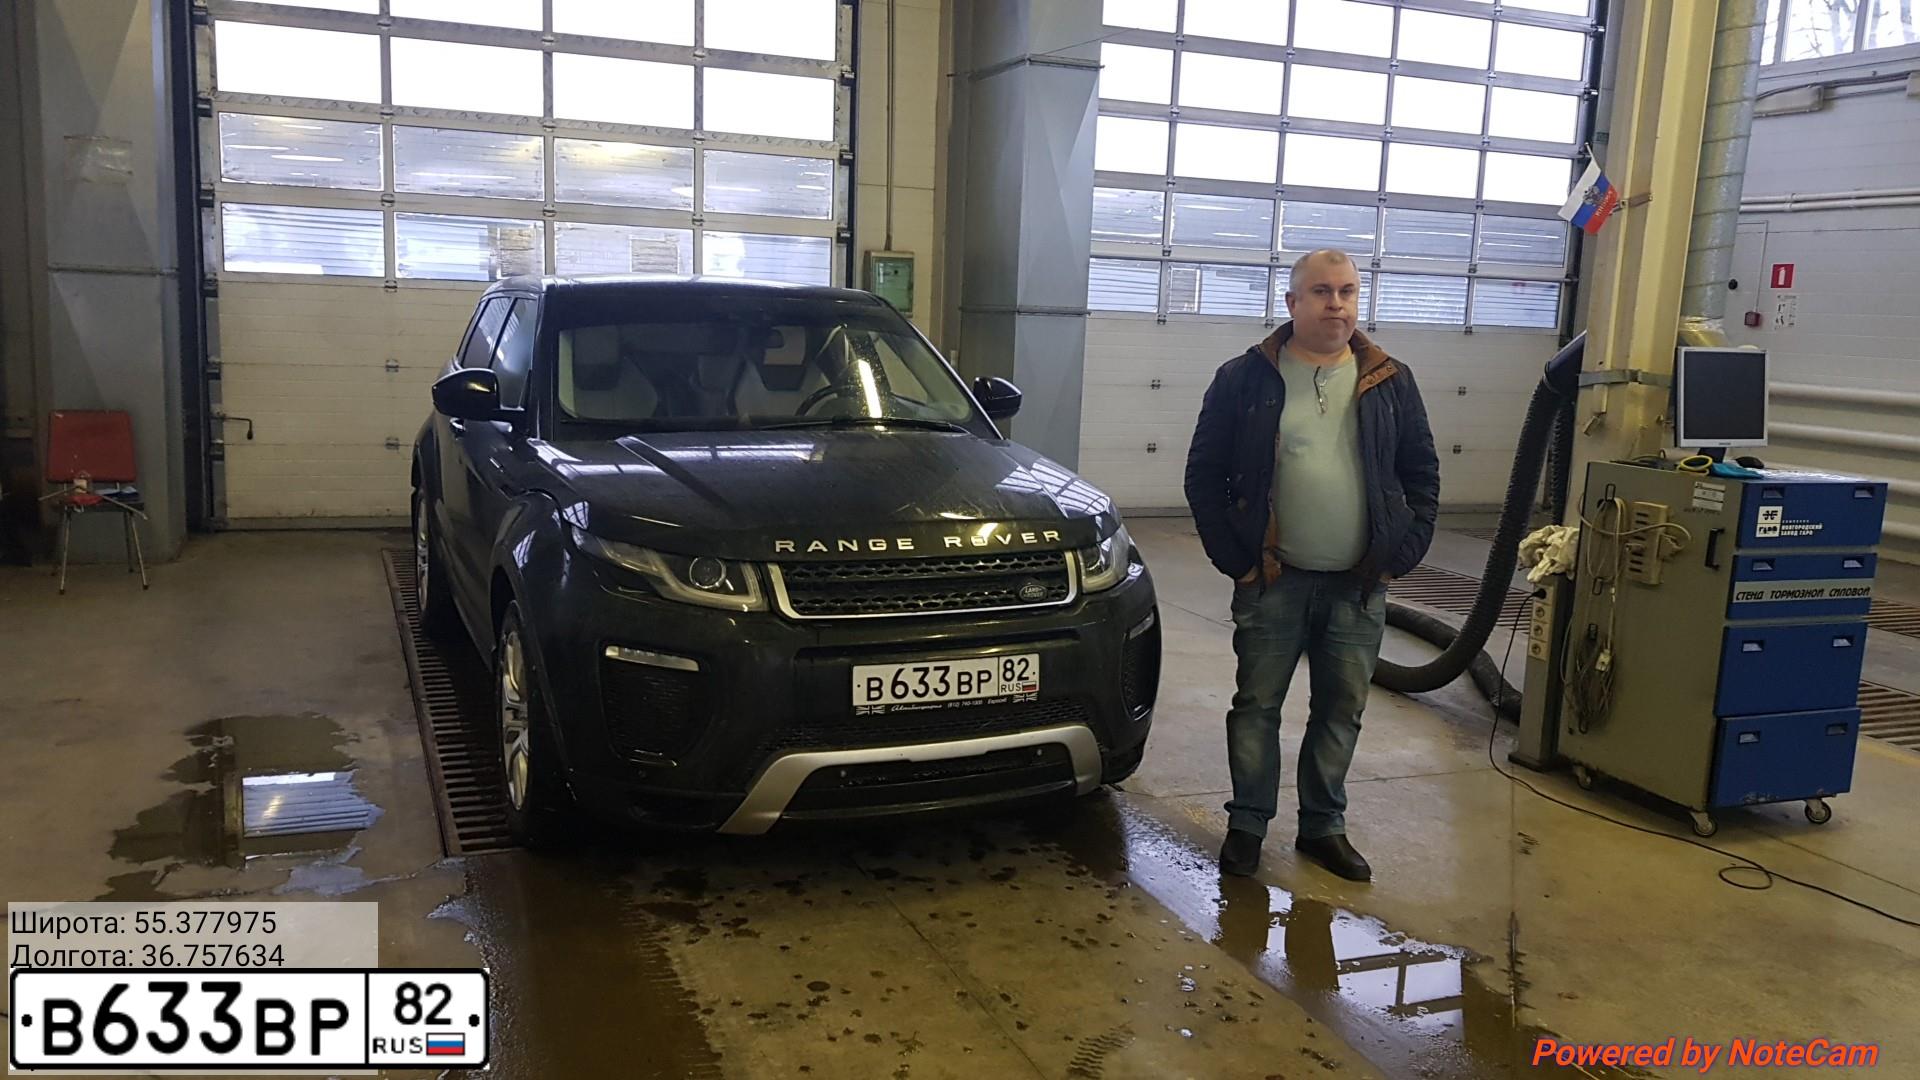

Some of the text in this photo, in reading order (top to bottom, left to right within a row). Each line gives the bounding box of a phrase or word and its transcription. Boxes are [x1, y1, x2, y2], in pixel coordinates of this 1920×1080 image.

[775, 530, 1061, 553] RANGE ROVER
[1735, 586, 1871, 601] СТЕНД ТОРМОЗНОЙ СИЛОВОЙ
[866, 657, 1030, 702] В633ВР 82
[1000, 683, 1022, 693] RUS
